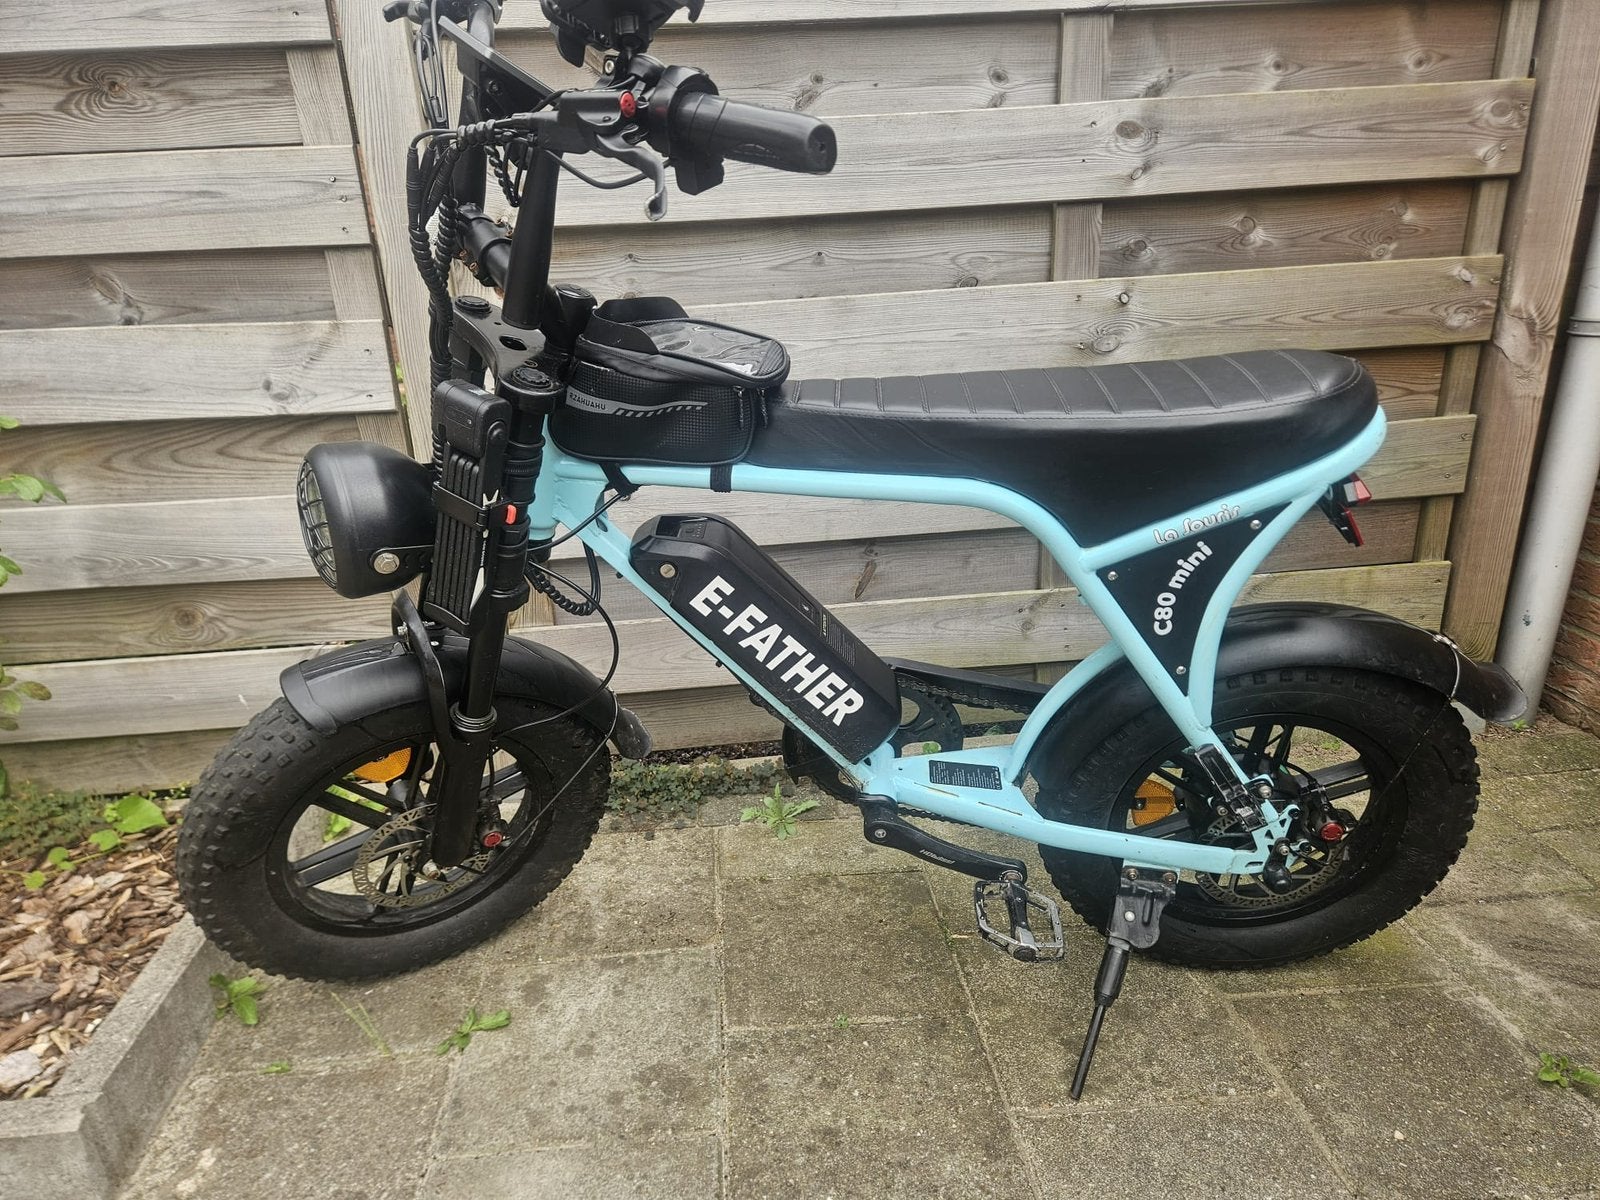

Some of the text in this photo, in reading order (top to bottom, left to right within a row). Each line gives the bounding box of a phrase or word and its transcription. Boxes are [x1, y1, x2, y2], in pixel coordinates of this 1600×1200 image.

[1153, 541, 1213, 635] C80 mini
[689, 575, 864, 726] E-FATHER
